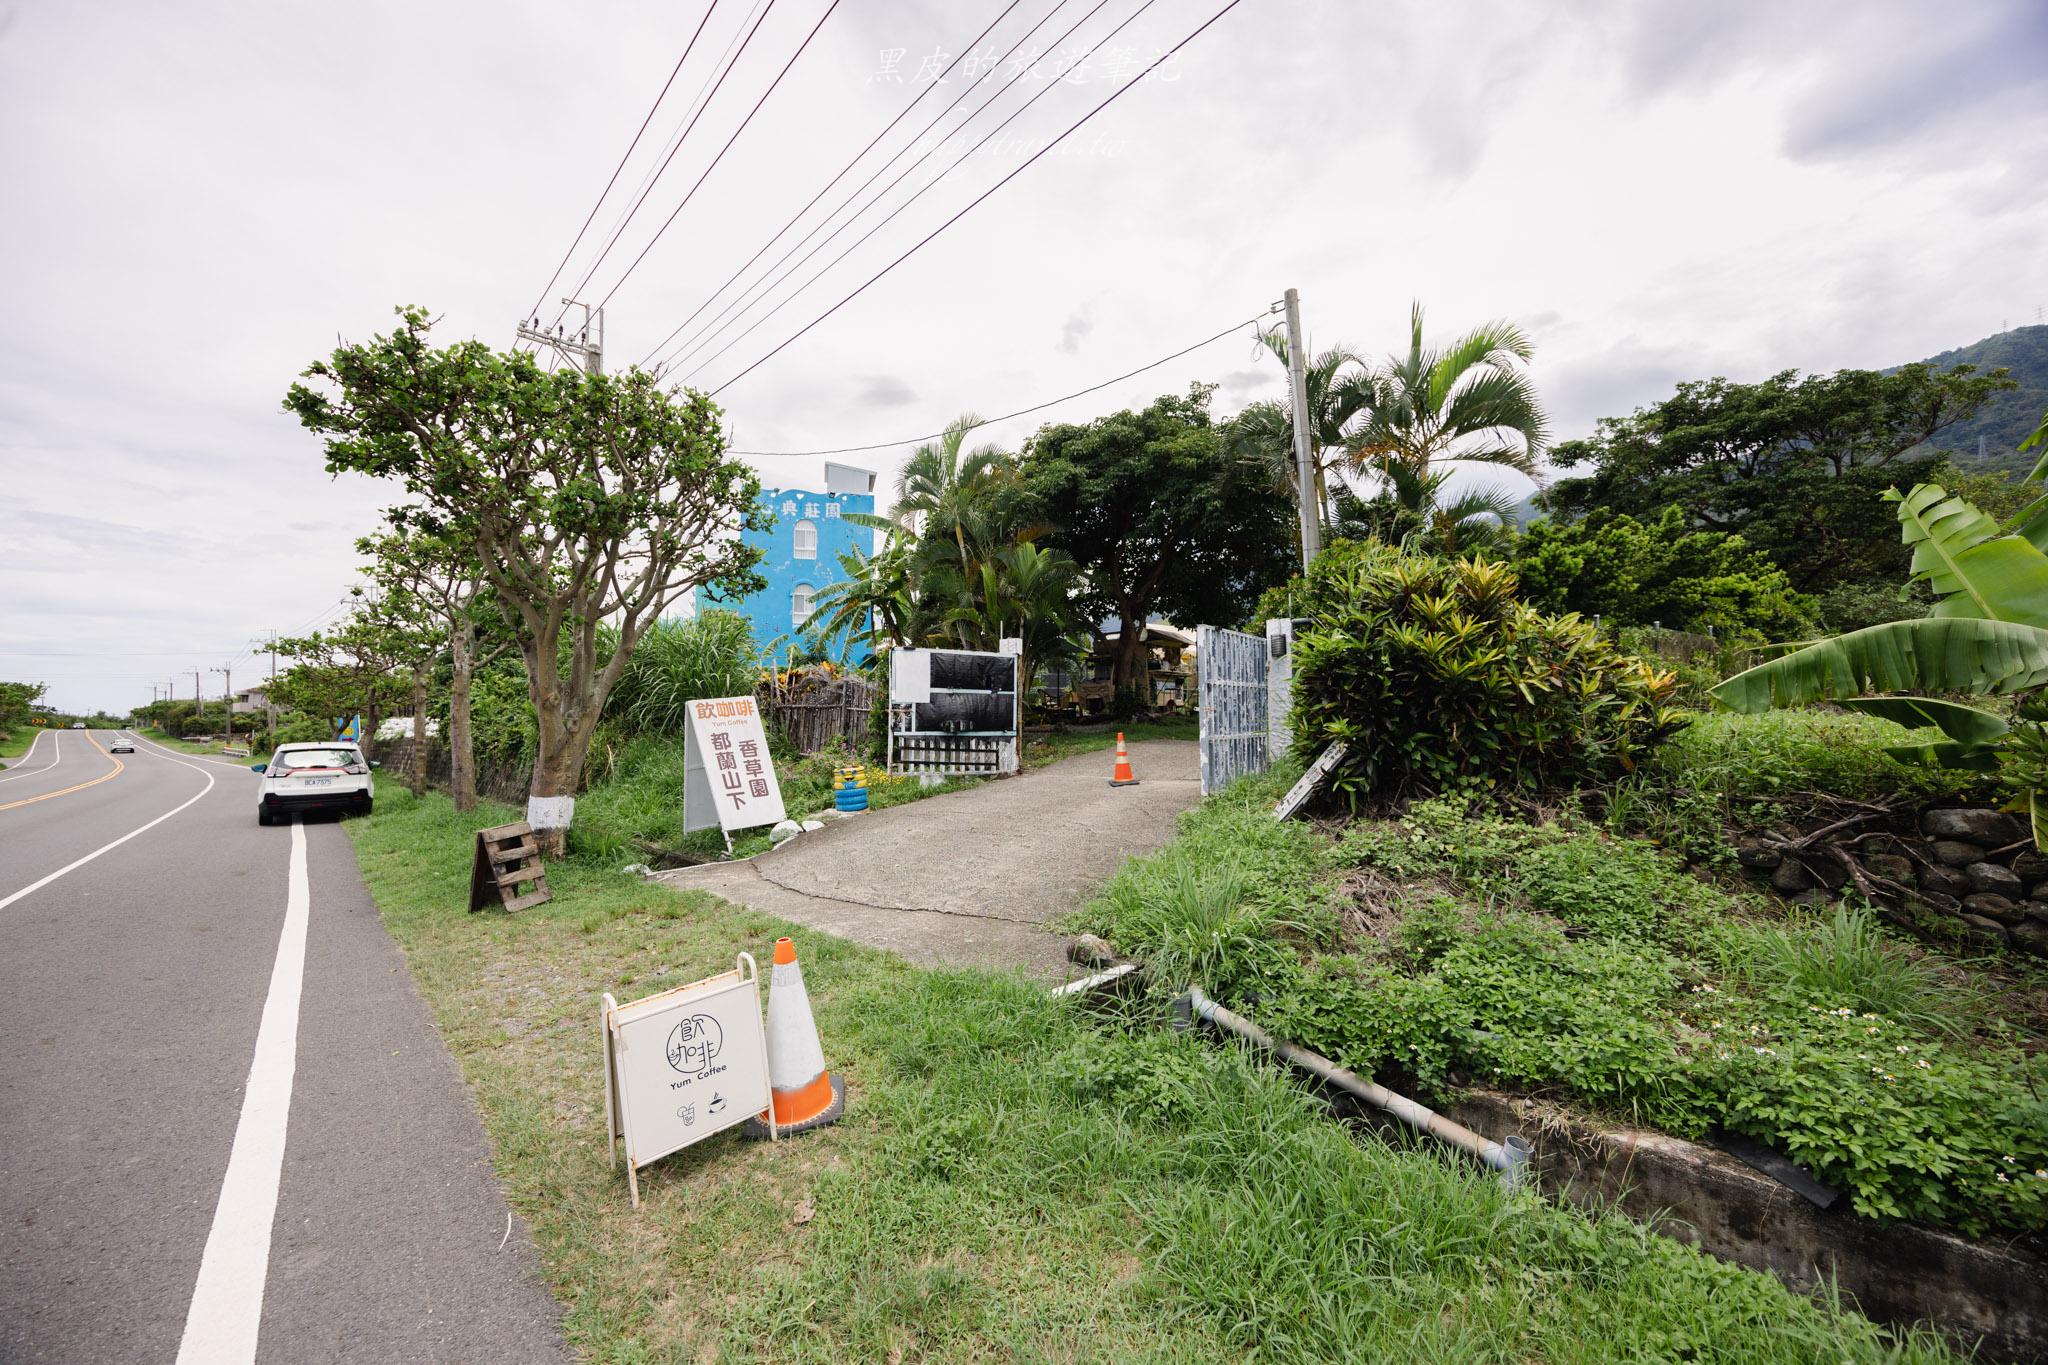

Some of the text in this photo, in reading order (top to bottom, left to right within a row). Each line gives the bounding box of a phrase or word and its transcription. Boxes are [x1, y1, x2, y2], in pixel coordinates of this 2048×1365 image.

[761, 500, 840, 519] 典莊園
[695, 701, 753, 720] 飲咖啡
[727, 719, 748, 727] Coffee
[710, 732, 747, 811] 都蘭山下
[738, 739, 769, 798] 香草園
[670, 1064, 727, 1091] Yum Coffee
